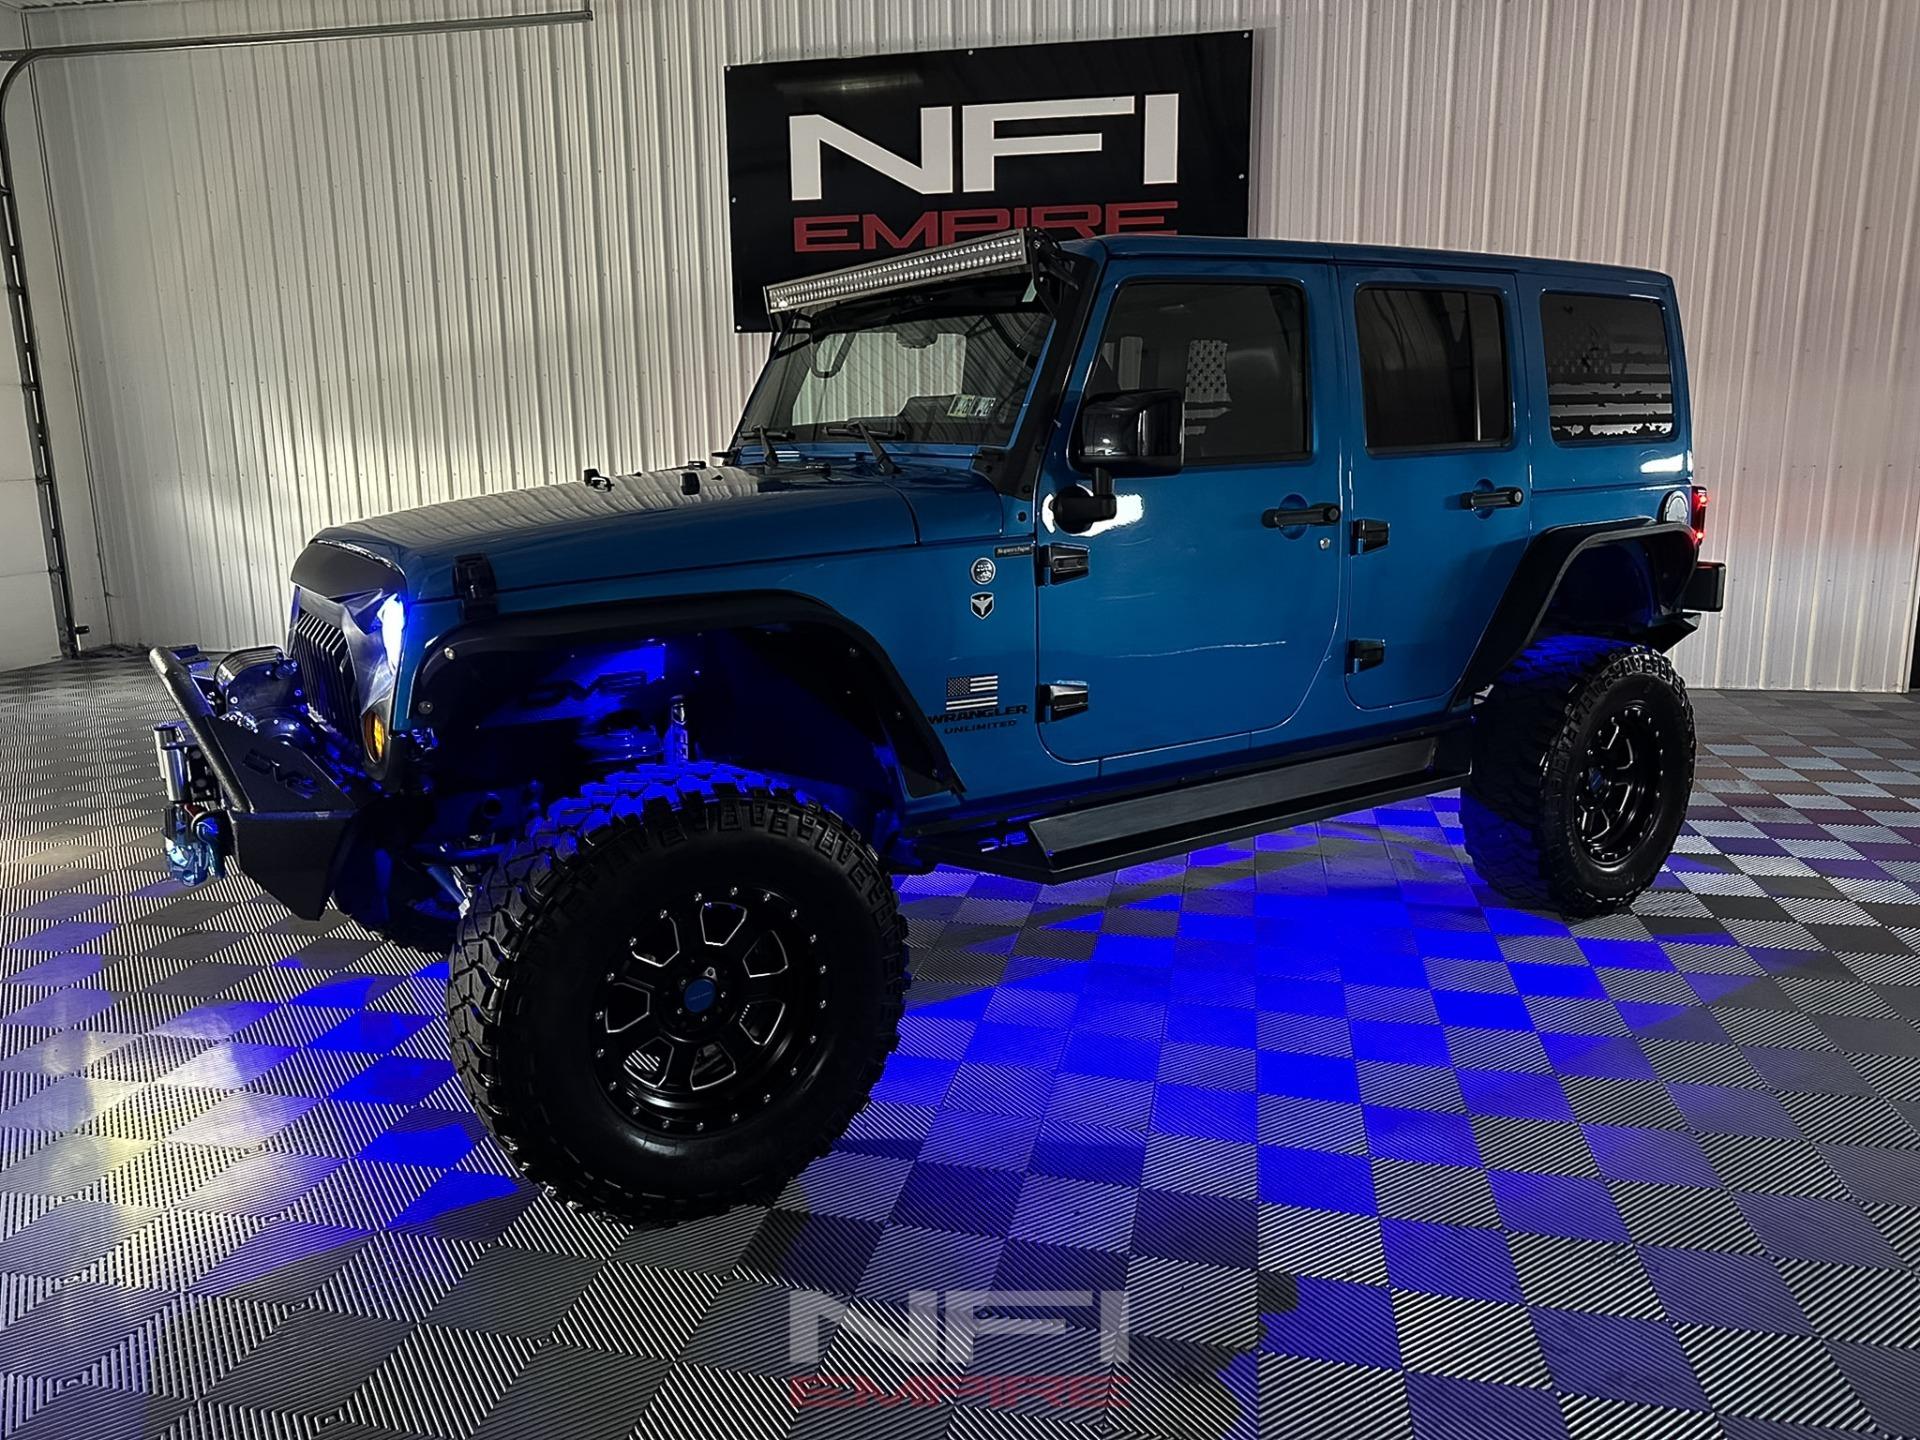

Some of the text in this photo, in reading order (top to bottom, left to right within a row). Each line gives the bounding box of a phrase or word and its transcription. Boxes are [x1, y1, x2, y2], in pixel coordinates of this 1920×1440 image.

[789, 93, 1179, 201] NFI
[793, 201, 1179, 253] EMPIRE
[927, 704, 1028, 724] WRANGLER
[944, 718, 1017, 735] UNLIMITED
